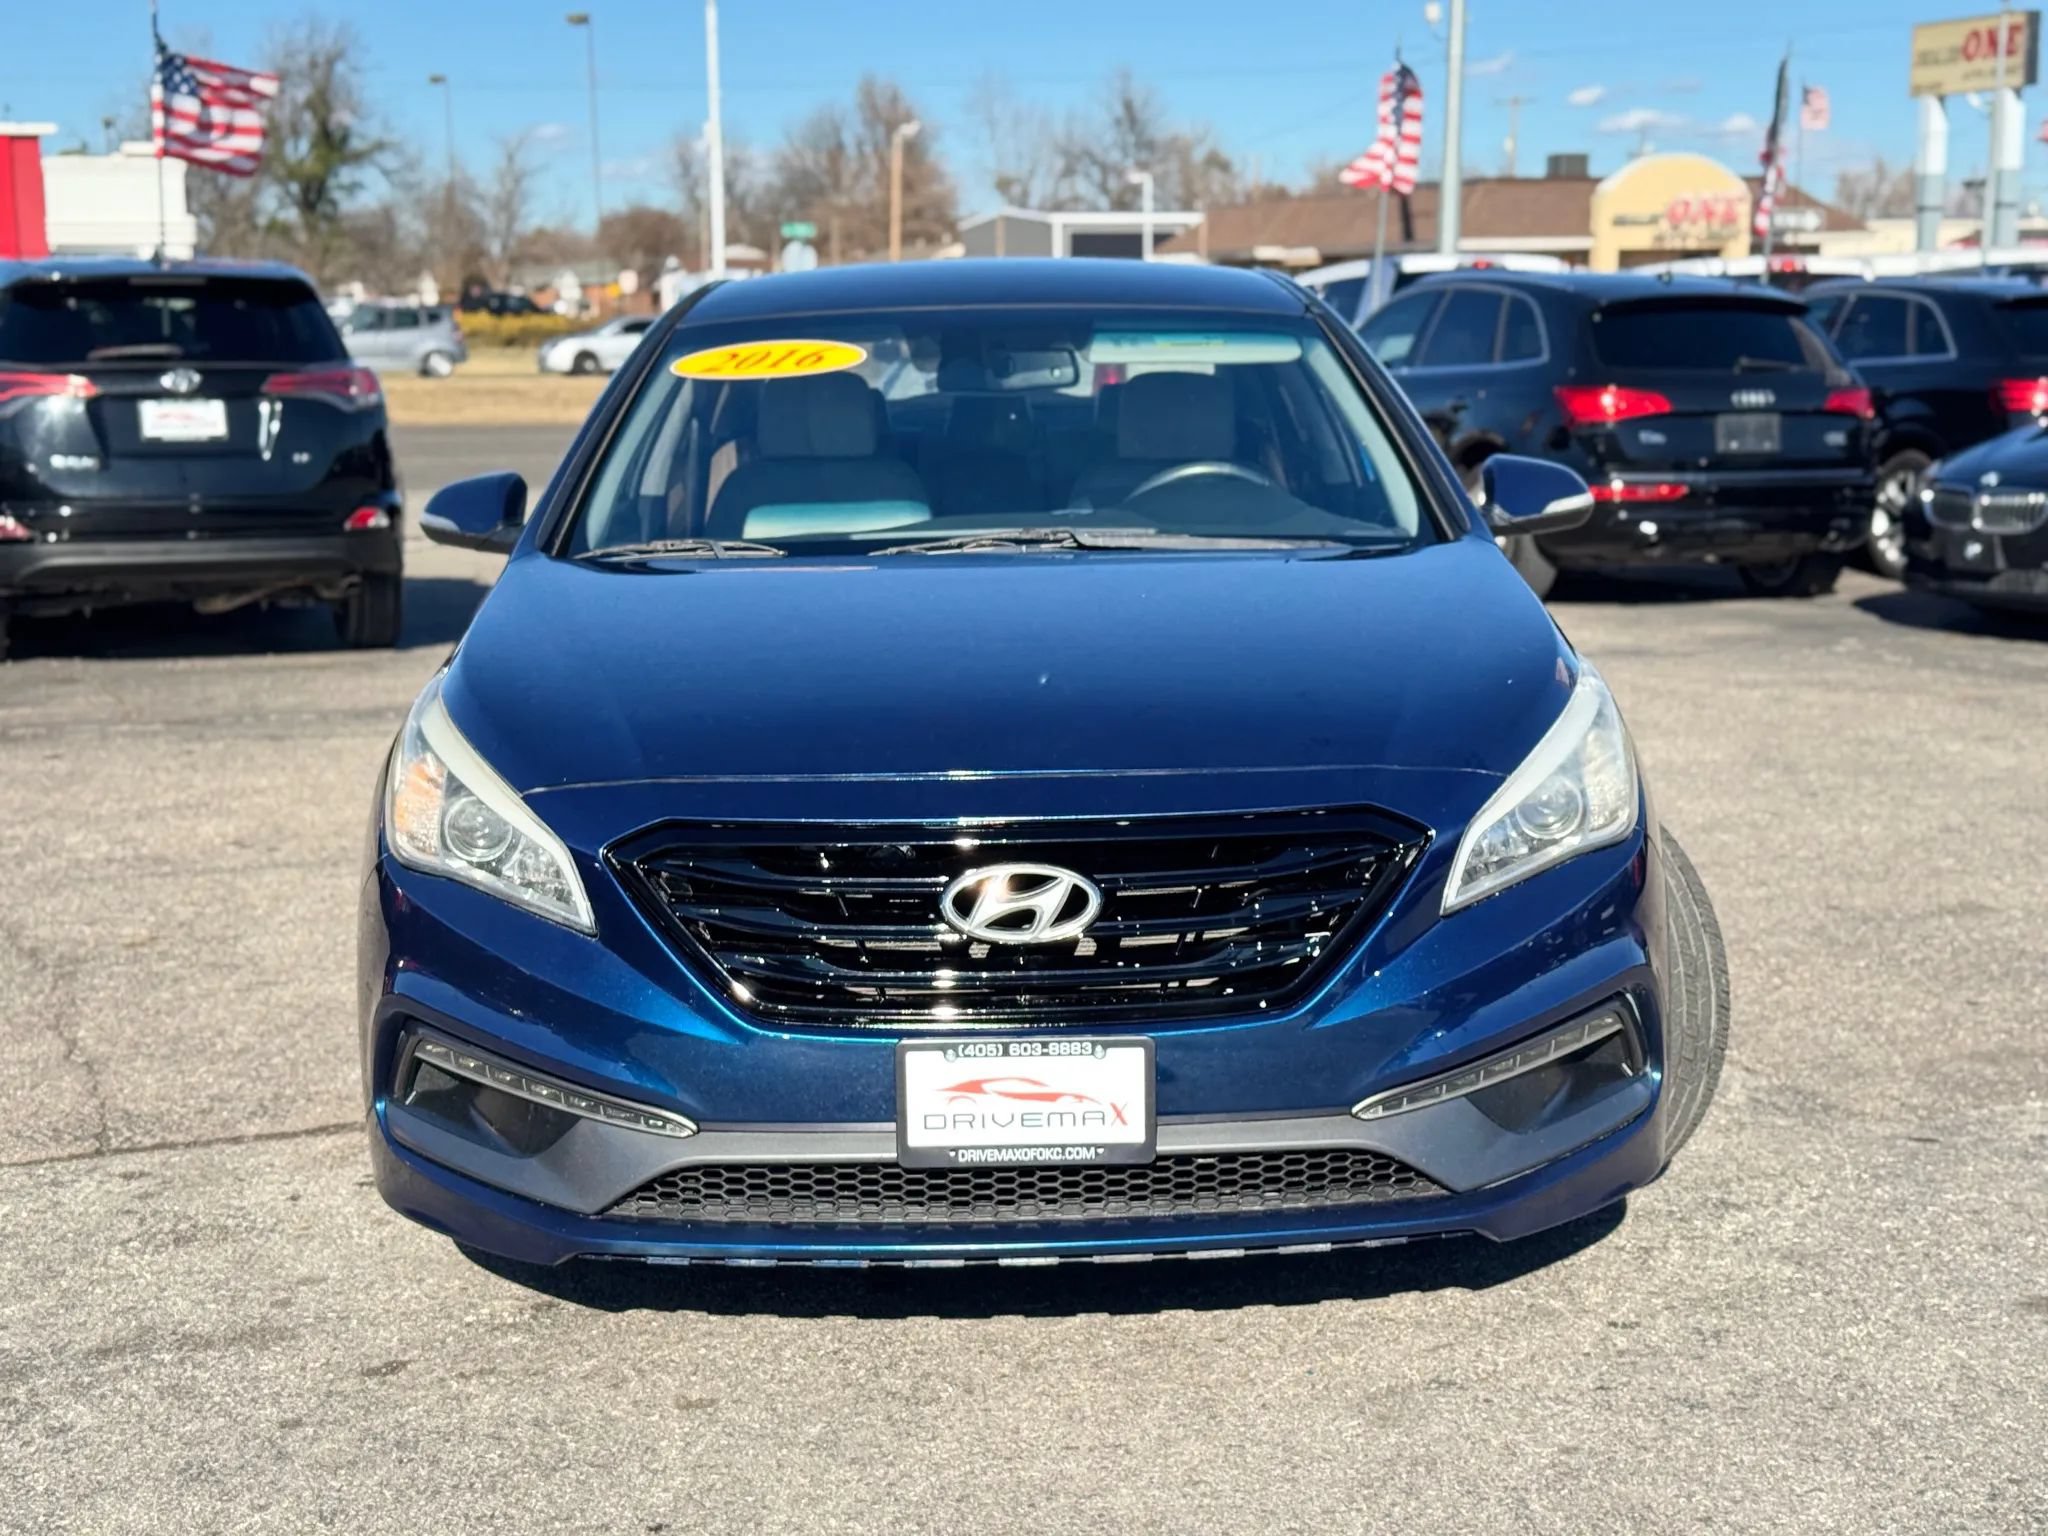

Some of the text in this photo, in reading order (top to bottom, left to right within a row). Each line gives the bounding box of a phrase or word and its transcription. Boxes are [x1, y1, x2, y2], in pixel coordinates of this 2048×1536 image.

[697, 346, 838, 374] 2016
[958, 1043, 1003, 1057] (405)
[923, 1102, 1128, 1130] DRIVEMAX
[957, 1146, 1096, 1163] DRIVEMAXOFOKC.COM
